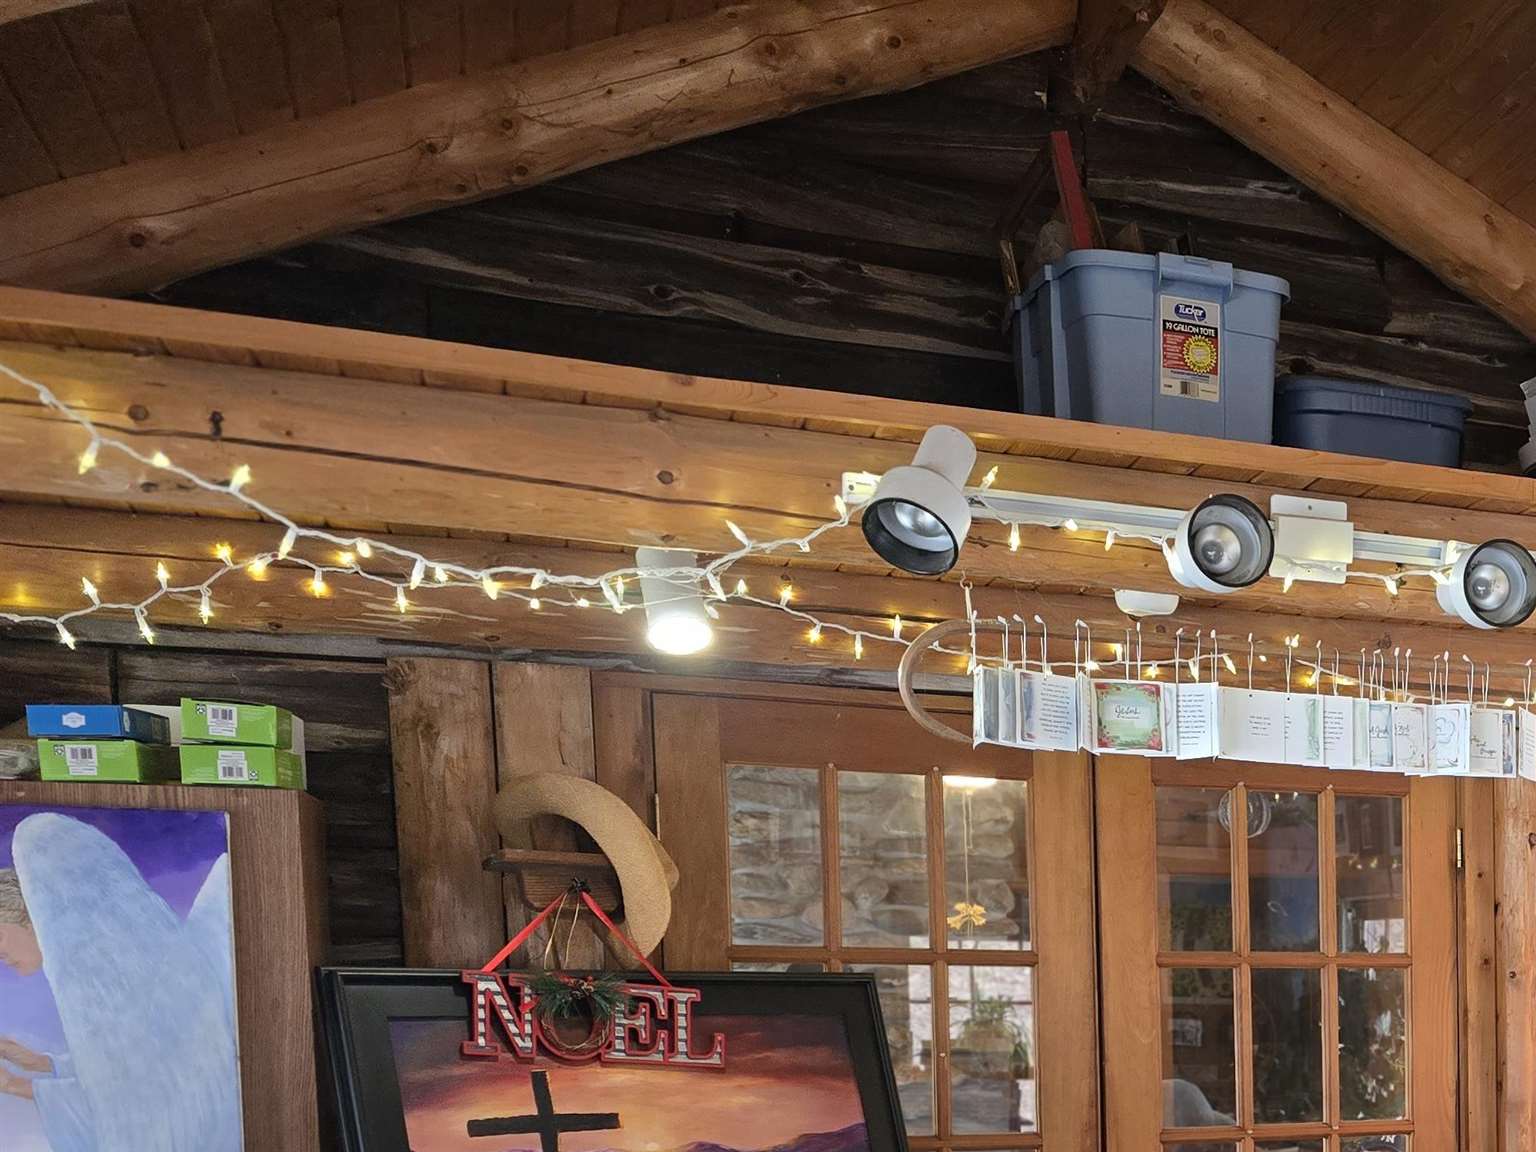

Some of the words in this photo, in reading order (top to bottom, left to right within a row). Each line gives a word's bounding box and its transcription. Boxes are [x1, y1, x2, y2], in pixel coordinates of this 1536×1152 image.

[1173, 322, 1199, 335] GALLON
[1200, 327, 1216, 337] TOTE
[461, 969, 727, 1067] NOEL
